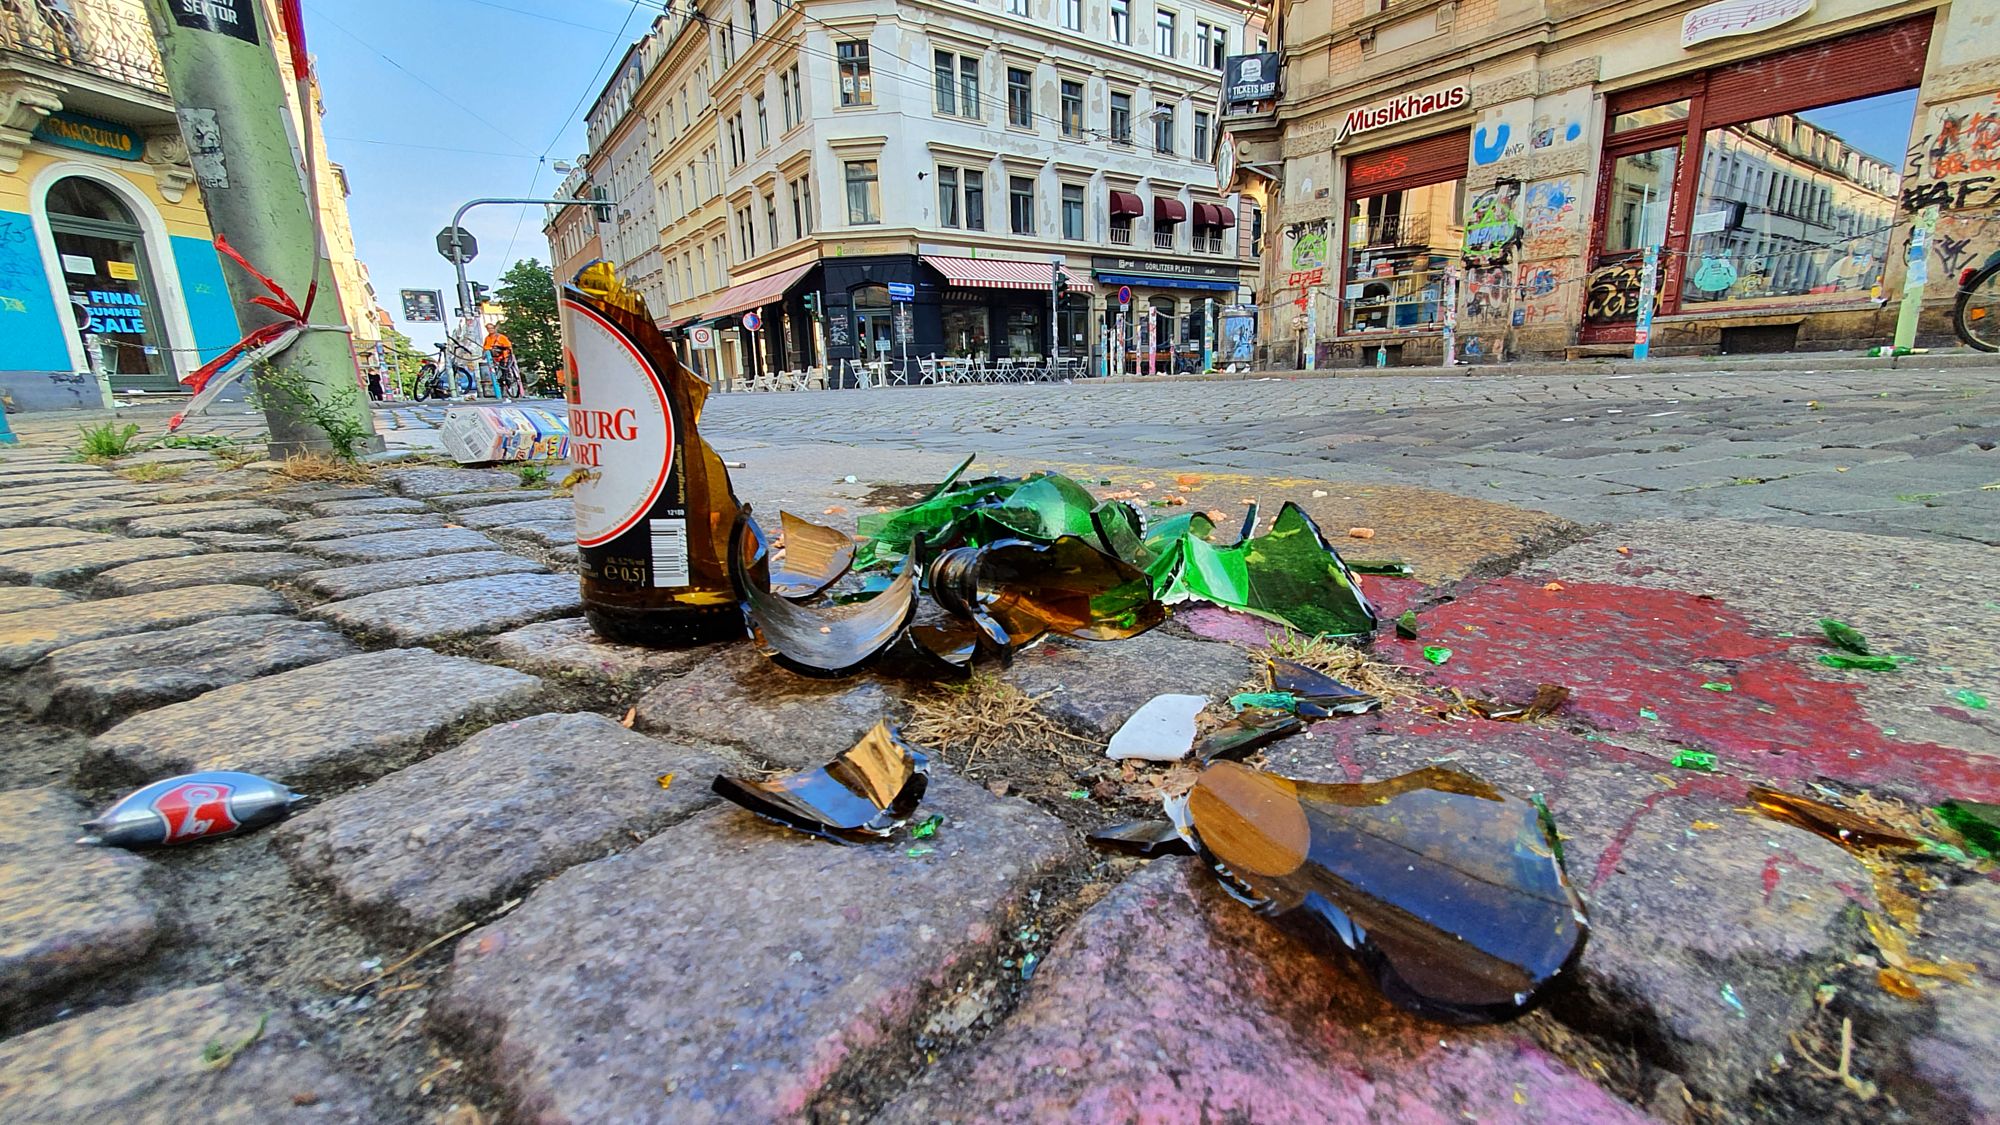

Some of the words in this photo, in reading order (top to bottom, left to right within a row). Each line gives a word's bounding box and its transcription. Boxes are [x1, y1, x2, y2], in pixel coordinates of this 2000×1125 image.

[182, 0, 239, 25] SEKTOR
[1233, 84, 1259, 96] TICKETS
[1260, 81, 1276, 93] HIER
[1336, 86, 1465, 142] Musikhaus
[1144, 262, 1175, 272] GÖRLITZER
[1174, 264, 1192, 273] PLATZ
[90, 291, 147, 306] FINAL
[88, 307, 142, 317] SUMMER
[91, 318, 147, 333] SALE
